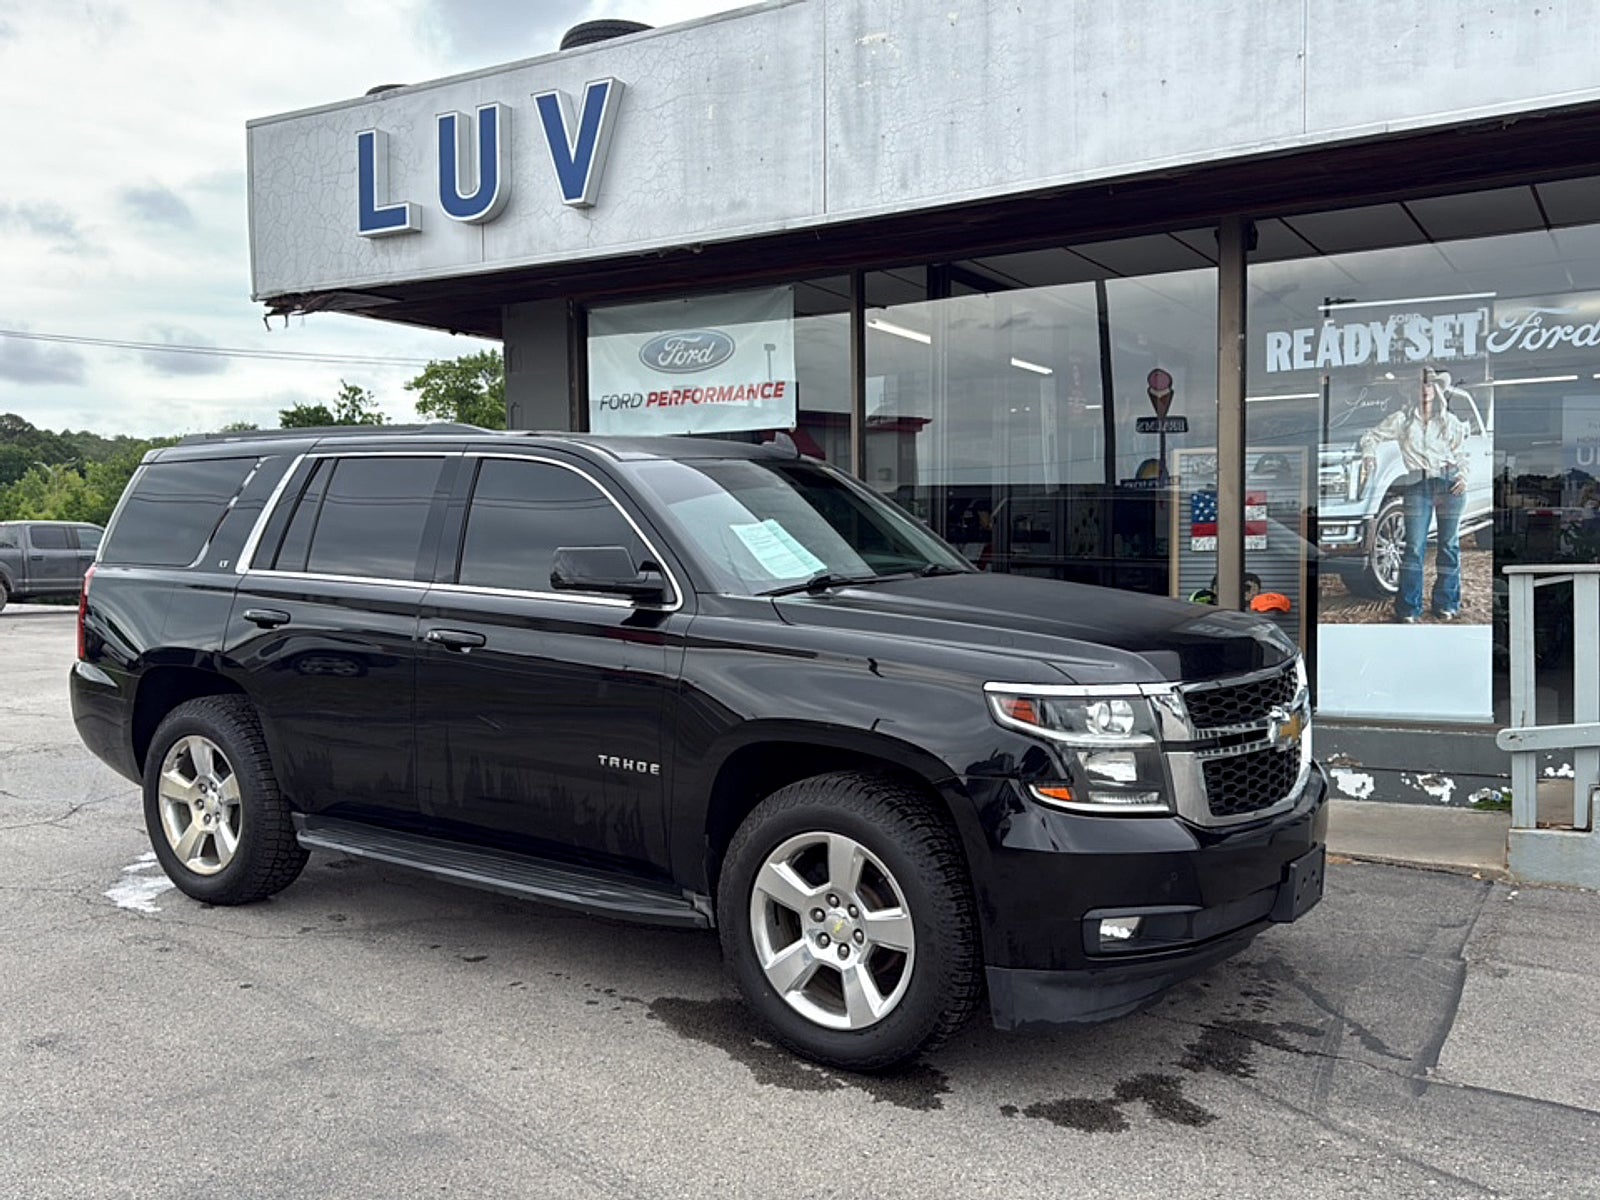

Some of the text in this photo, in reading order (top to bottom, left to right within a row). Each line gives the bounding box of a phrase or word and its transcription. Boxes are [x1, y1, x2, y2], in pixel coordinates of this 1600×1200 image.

[356, 77, 625, 238] LUV
[657, 336, 715, 366] Ford
[1266, 306, 1600, 373] READY SET Ford
[600, 380, 786, 411] FORD PERFORMANCE
[597, 754, 661, 775] TAHOE
